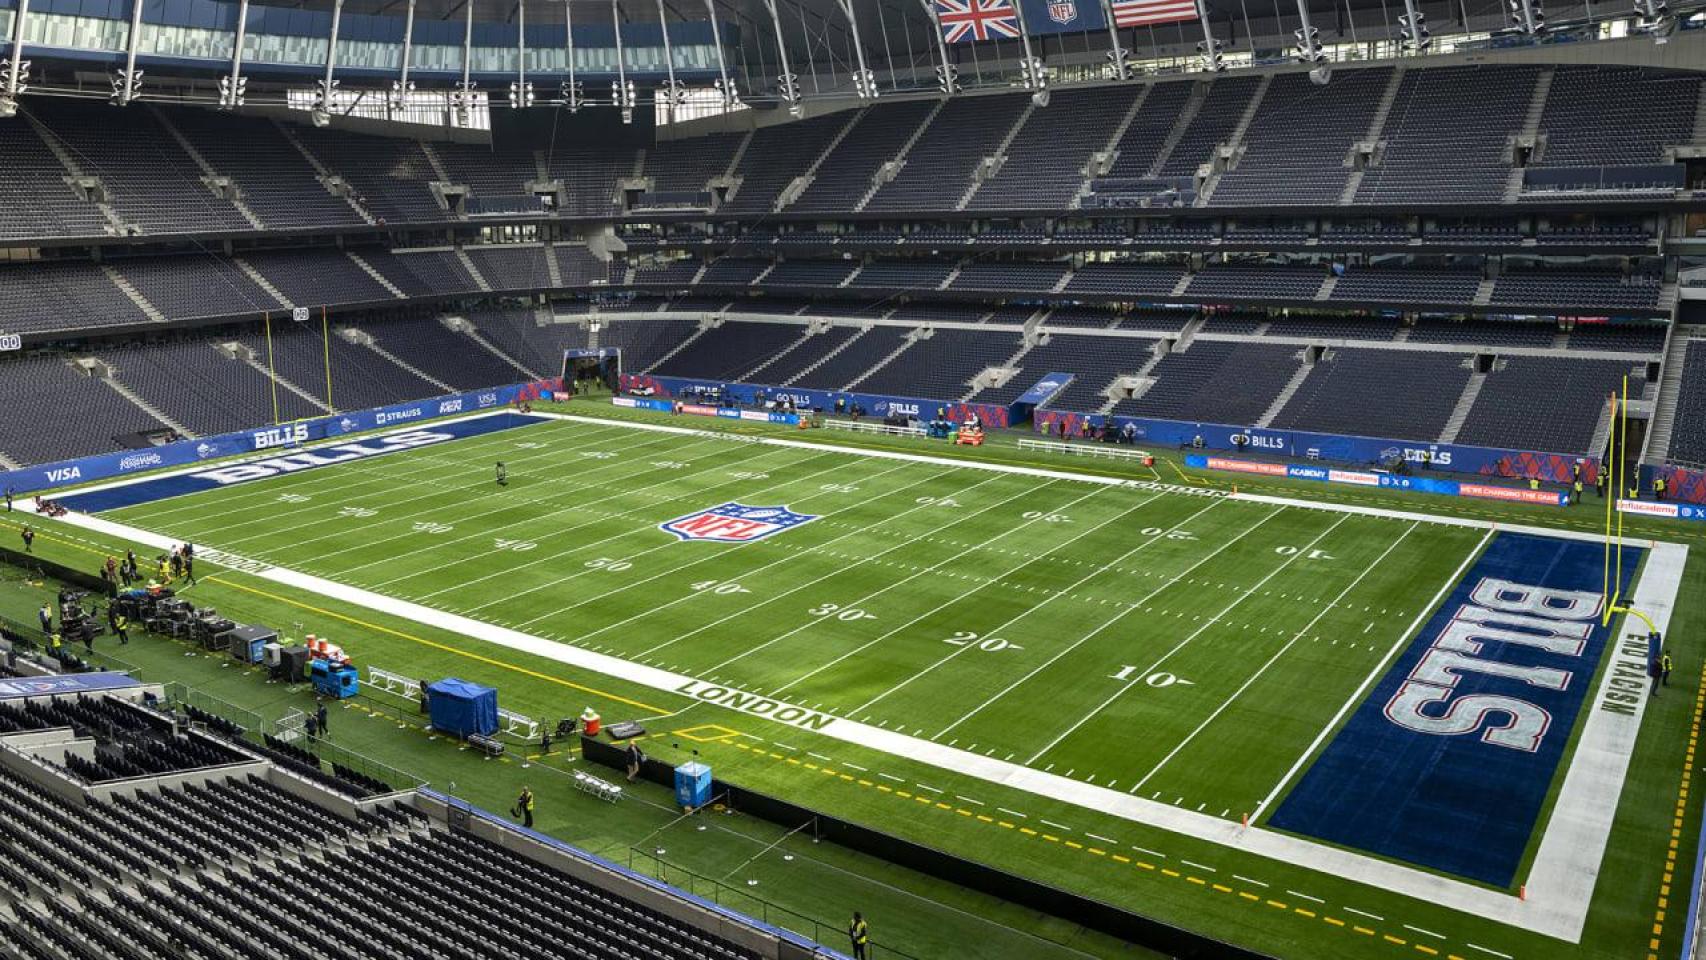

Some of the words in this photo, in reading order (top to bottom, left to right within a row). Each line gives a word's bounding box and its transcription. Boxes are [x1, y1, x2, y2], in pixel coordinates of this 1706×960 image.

[1051, 4, 1074, 19] NFL
[386, 407, 421, 421] STRAUSS
[254, 423, 309, 449] BILLS
[1252, 435, 1284, 449] BILLS
[189, 431, 455, 484] BILLS
[44, 466, 81, 482] VISA
[1289, 467, 1326, 478] ACADEMY
[673, 515, 767, 538] NFL
[584, 557, 633, 571] 50
[690, 580, 738, 596] 40
[808, 603, 864, 622] 30
[942, 631, 1007, 653] 20
[1621, 633, 1649, 658] END
[1382, 576, 1606, 753] BILLS
[1107, 664, 1176, 689] 10
[1601, 660, 1646, 716] RACISM
[675, 680, 836, 730] LONDON
